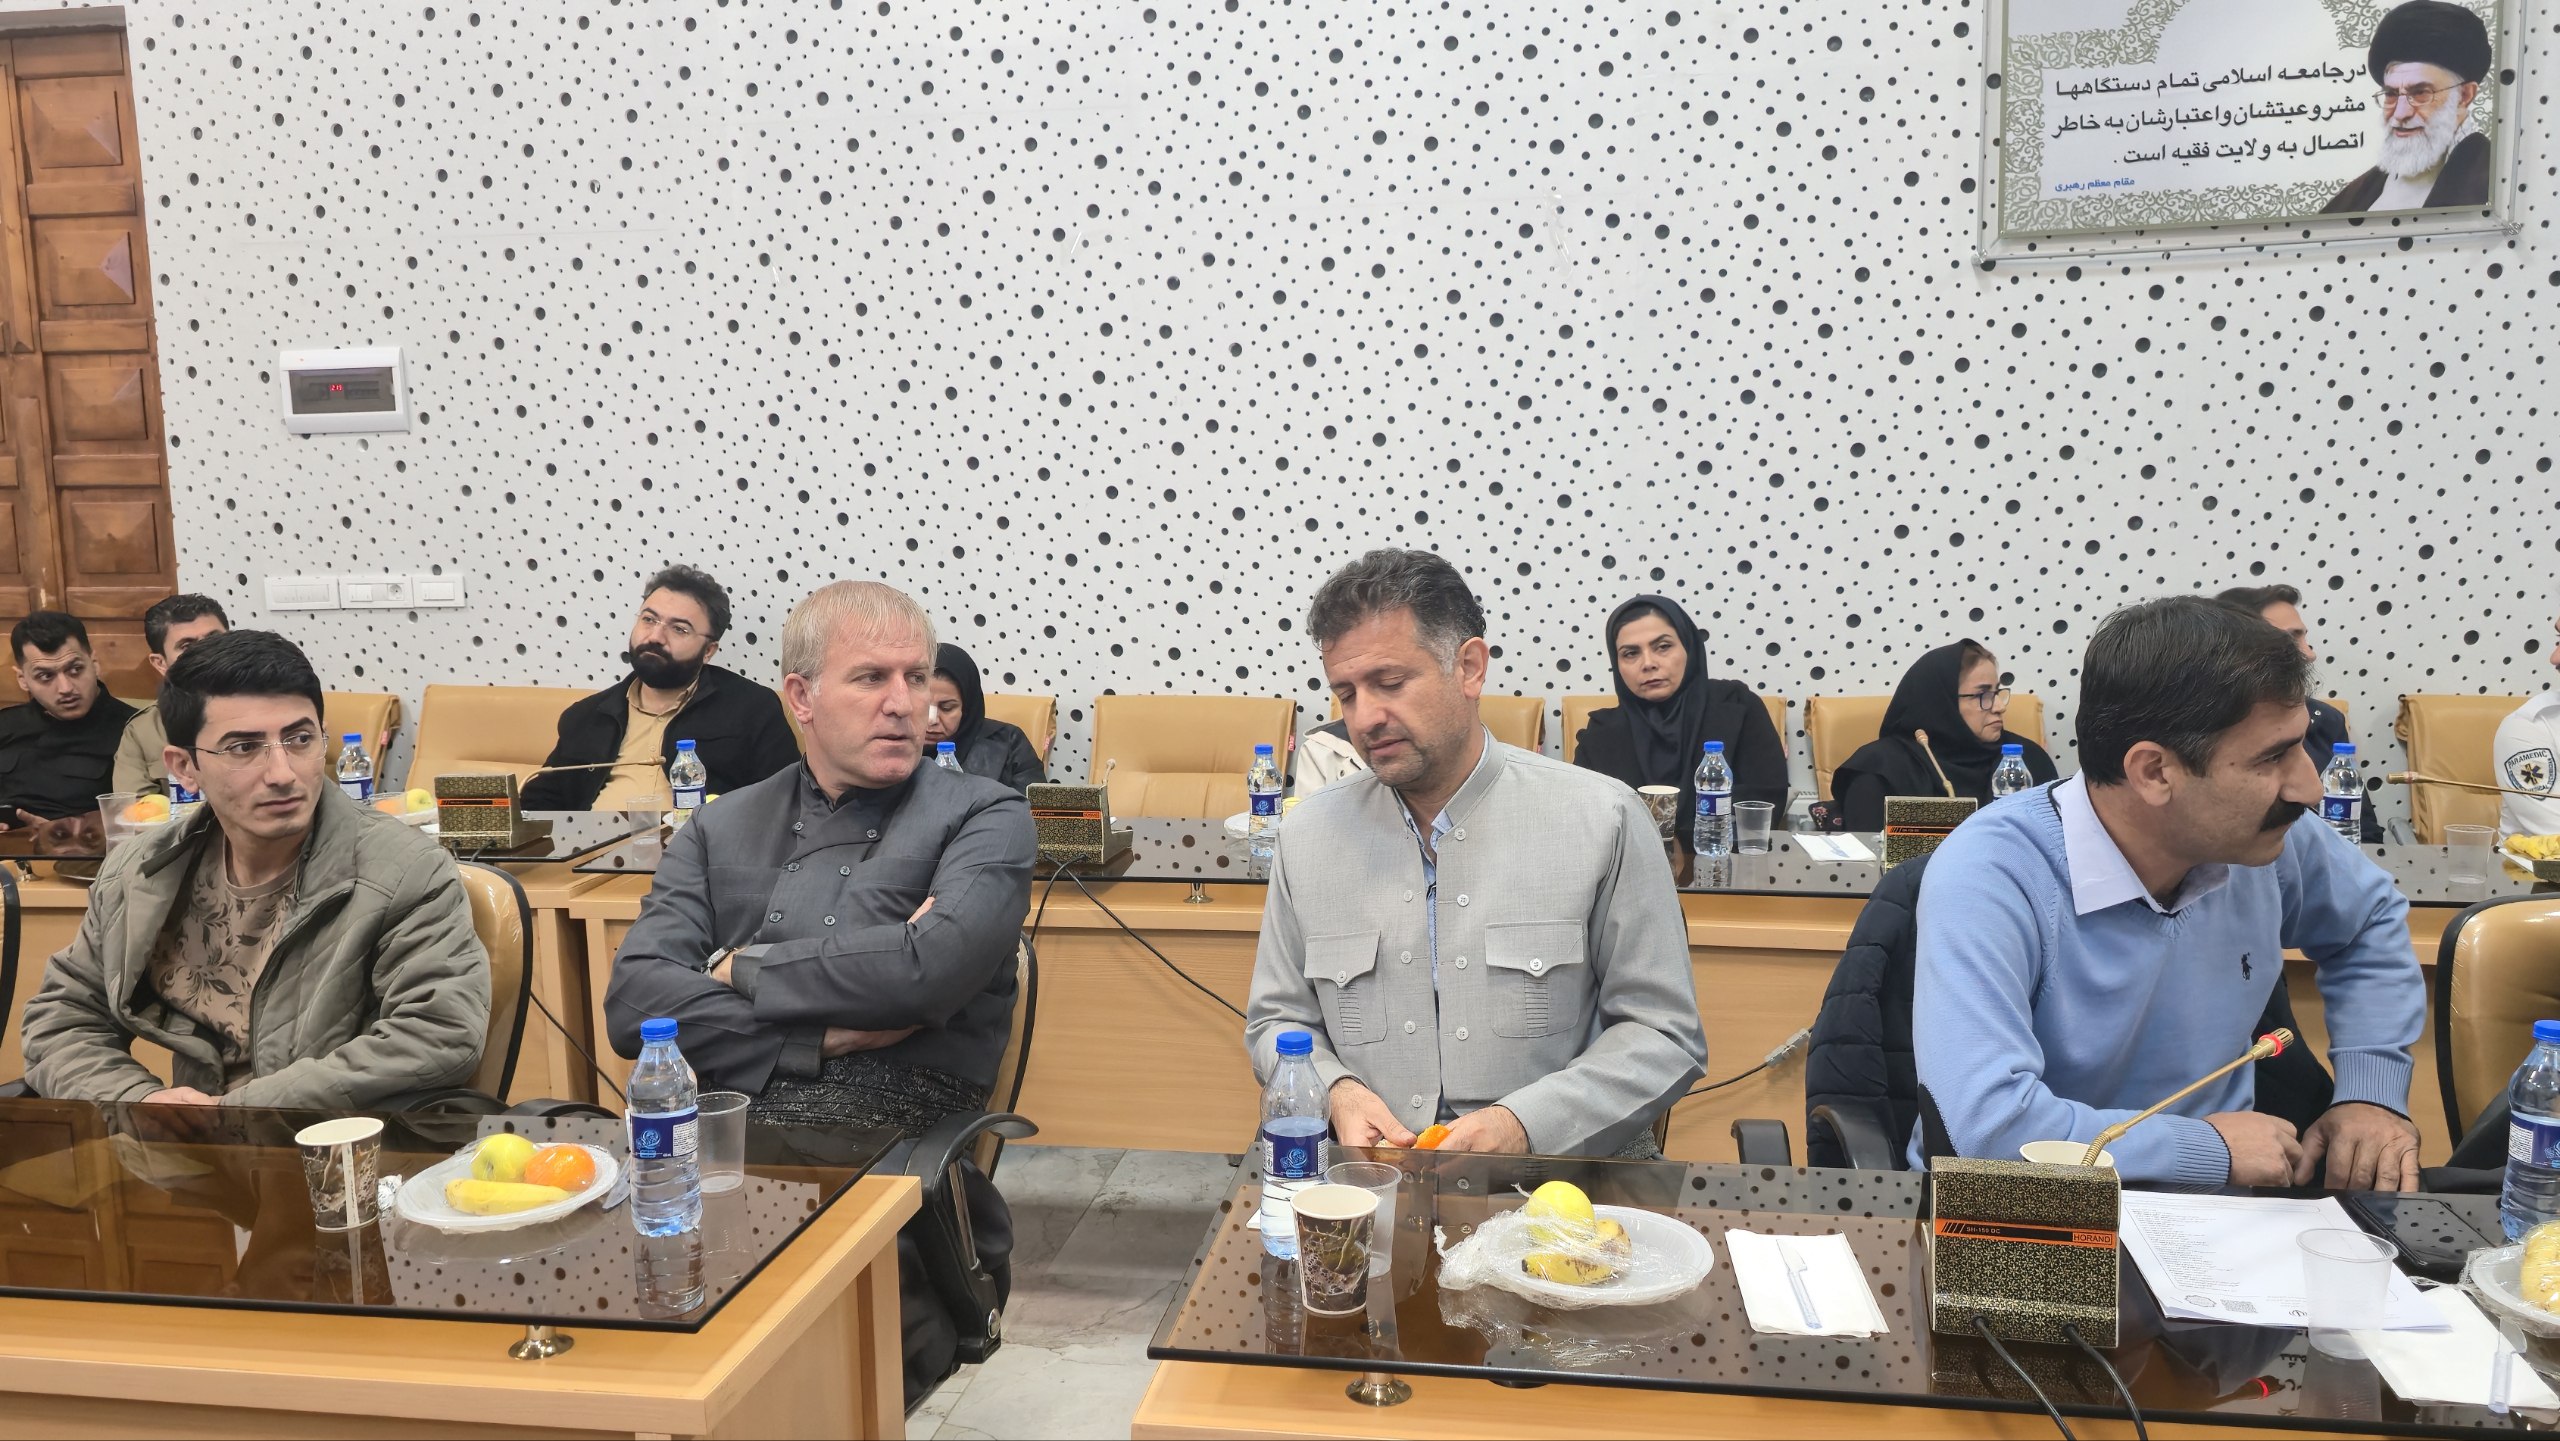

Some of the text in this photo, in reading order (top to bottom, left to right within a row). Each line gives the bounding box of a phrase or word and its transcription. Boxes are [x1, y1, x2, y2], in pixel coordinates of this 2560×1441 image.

[2056, 77, 2151, 100] دستگاهها
[2157, 72, 2199, 98] تمام
[2203, 65, 2272, 92] اسلامی
[2233, 95, 2366, 125] مشروعیتشان
[2051, 114, 2101, 138] خاطر
[2104, 116, 2124, 134] به
[2171, 141, 2210, 166] فقیه
[2215, 137, 2271, 163] ولایت
[2277, 140, 2297, 159] به
[2303, 131, 2364, 156] اتصال
[2055, 178, 2135, 192] مقام معظم رهبری
[2508, 750, 2547, 769] PARAMEDIC
[2073, 1233, 2111, 1243] HORAND
